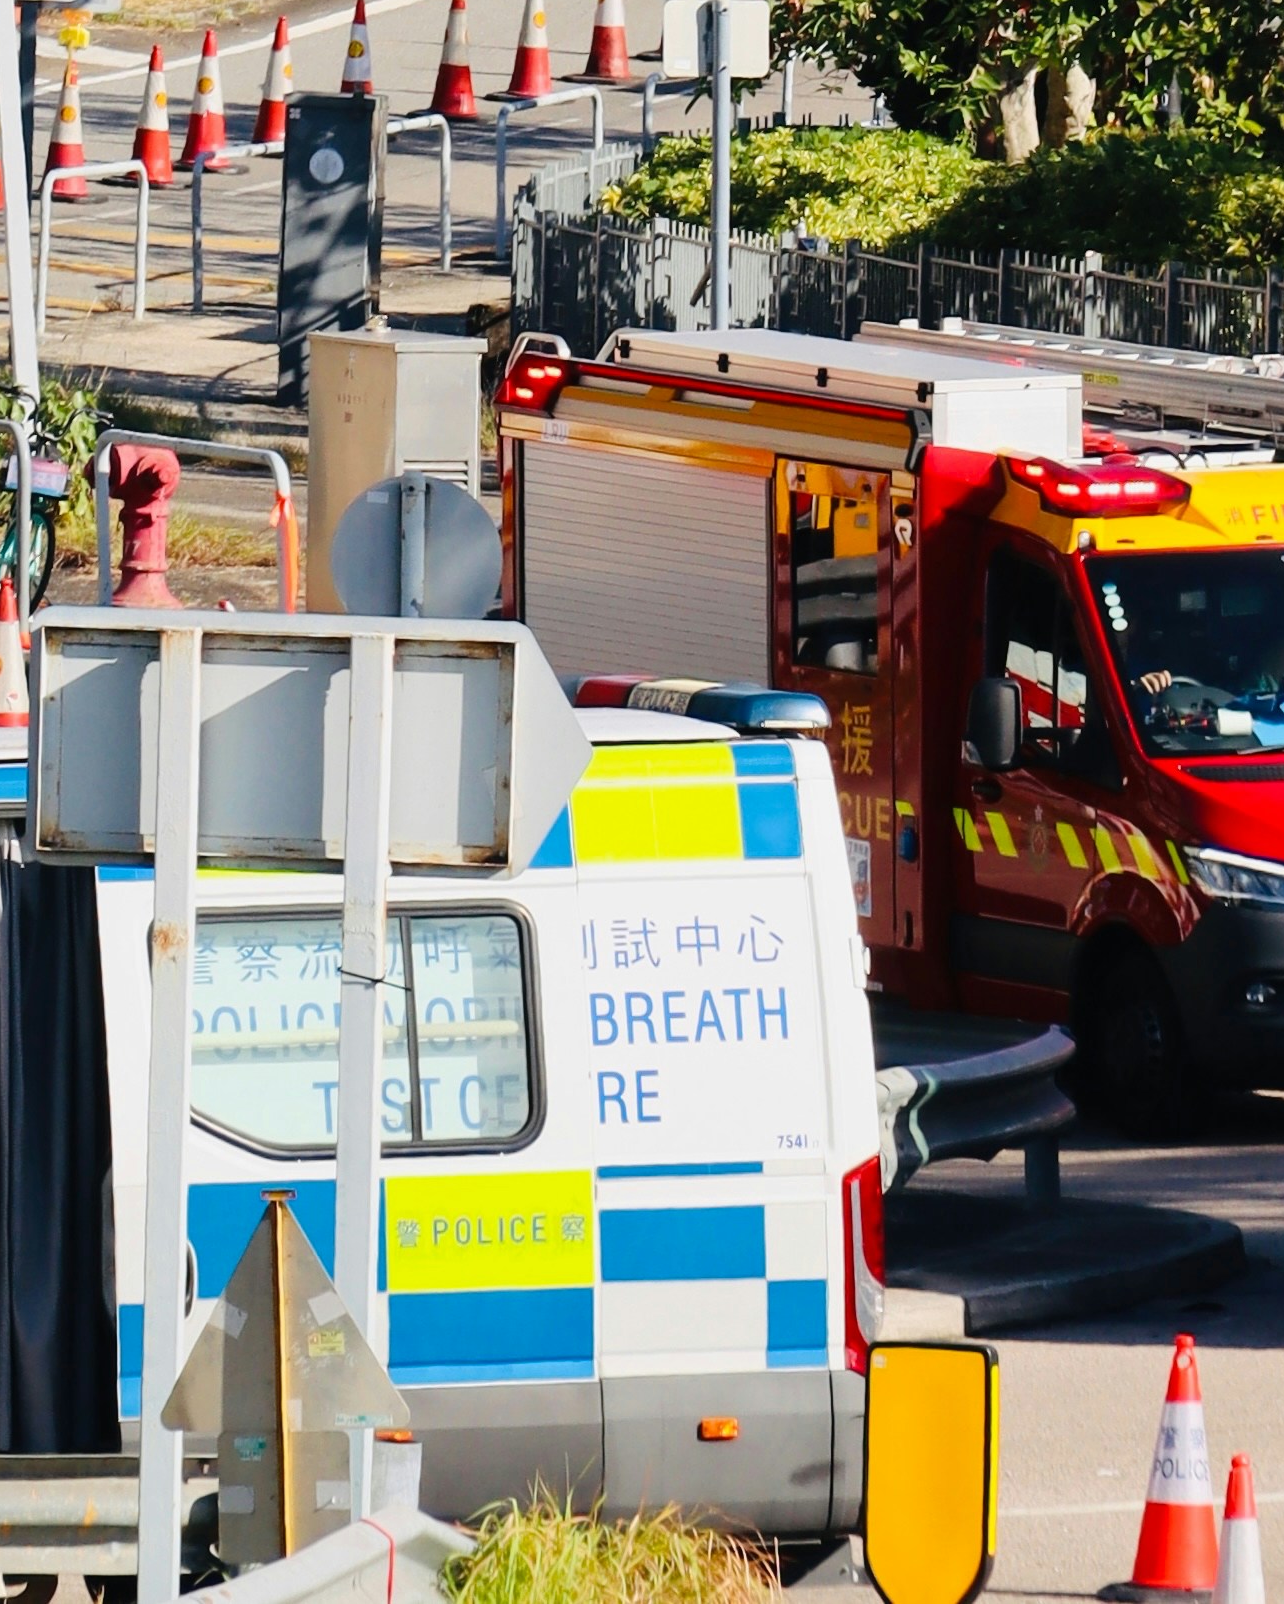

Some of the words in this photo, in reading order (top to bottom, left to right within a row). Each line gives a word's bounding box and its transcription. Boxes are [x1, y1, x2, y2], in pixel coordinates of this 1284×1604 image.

[842, 701, 873, 775] 援
[589, 987, 788, 1046] BREATH
[777, 1134, 808, 1149] 7541
[397, 1219, 421, 1248] 警
[433, 1214, 547, 1246] POLICE
[560, 1213, 586, 1242] 察
